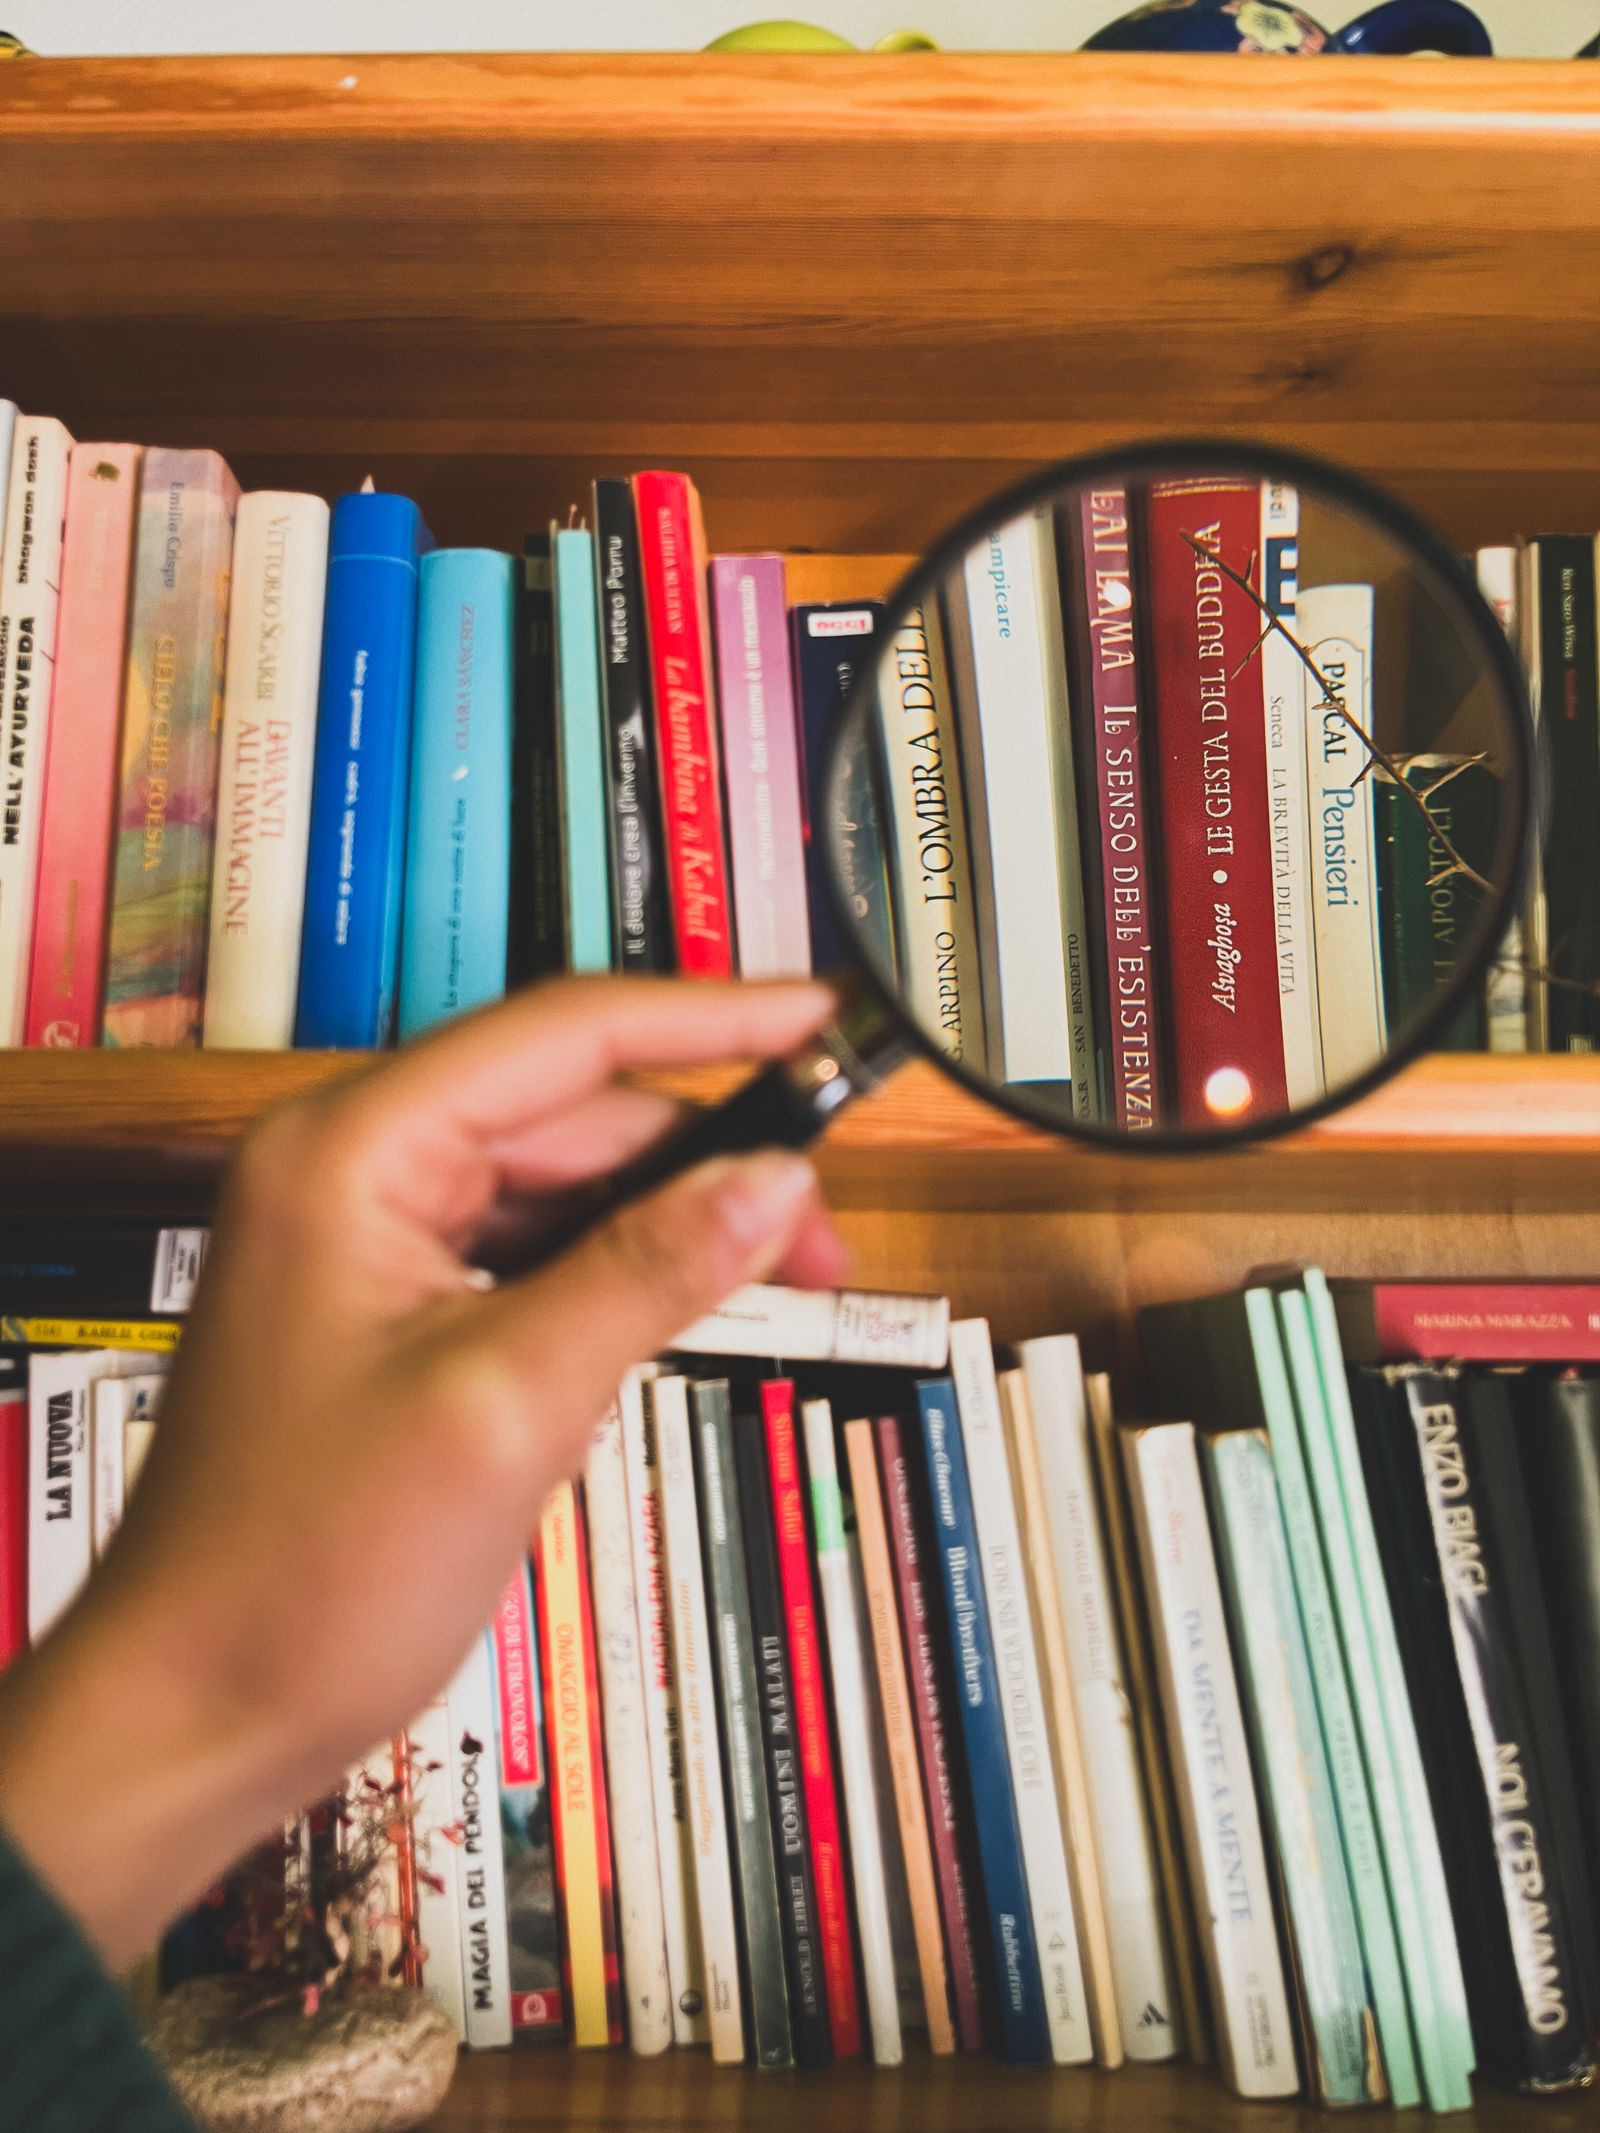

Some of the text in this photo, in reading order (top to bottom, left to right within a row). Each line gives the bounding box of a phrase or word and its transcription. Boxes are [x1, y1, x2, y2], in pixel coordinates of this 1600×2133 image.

[606, 535, 629, 664] Matteo Porru
[3, 613, 35, 846] NELL'AYURVEDA
[1103, 705, 1137, 735] IL
[1195, 520, 1234, 856] LE GESTA DEL BUDDHA
[1270, 696, 1284, 748] Seneca
[260, 719, 292, 838] DAVANTI
[908, 726, 957, 903] L'OMBRA
[1105, 748, 1137, 852] SENSO
[622, 816, 640, 863] crea
[1272, 768, 1296, 994] LA BREVITÀ DELLA VITA
[1322, 787, 1358, 907] Pensieri
[624, 866, 644, 936] dolore
[681, 848, 722, 940] Kabul
[936, 931, 962, 1034] ARPINO
[1067, 933, 1084, 1014] BENEDETTO
[1074, 1024, 1086, 1053] SAN
[46, 1390, 73, 1521] LA NUOVA
[1421, 1404, 1469, 1497] ENZO
[556, 1622, 587, 1812] OMAGGIO AL SOLE
[762, 1636, 788, 1736] MALATI
[775, 1749, 802, 1856] UOMINI
[1496, 1743, 1528, 1812] NOI
[463, 1742, 492, 2010] MAGIA DEL PENDOL
